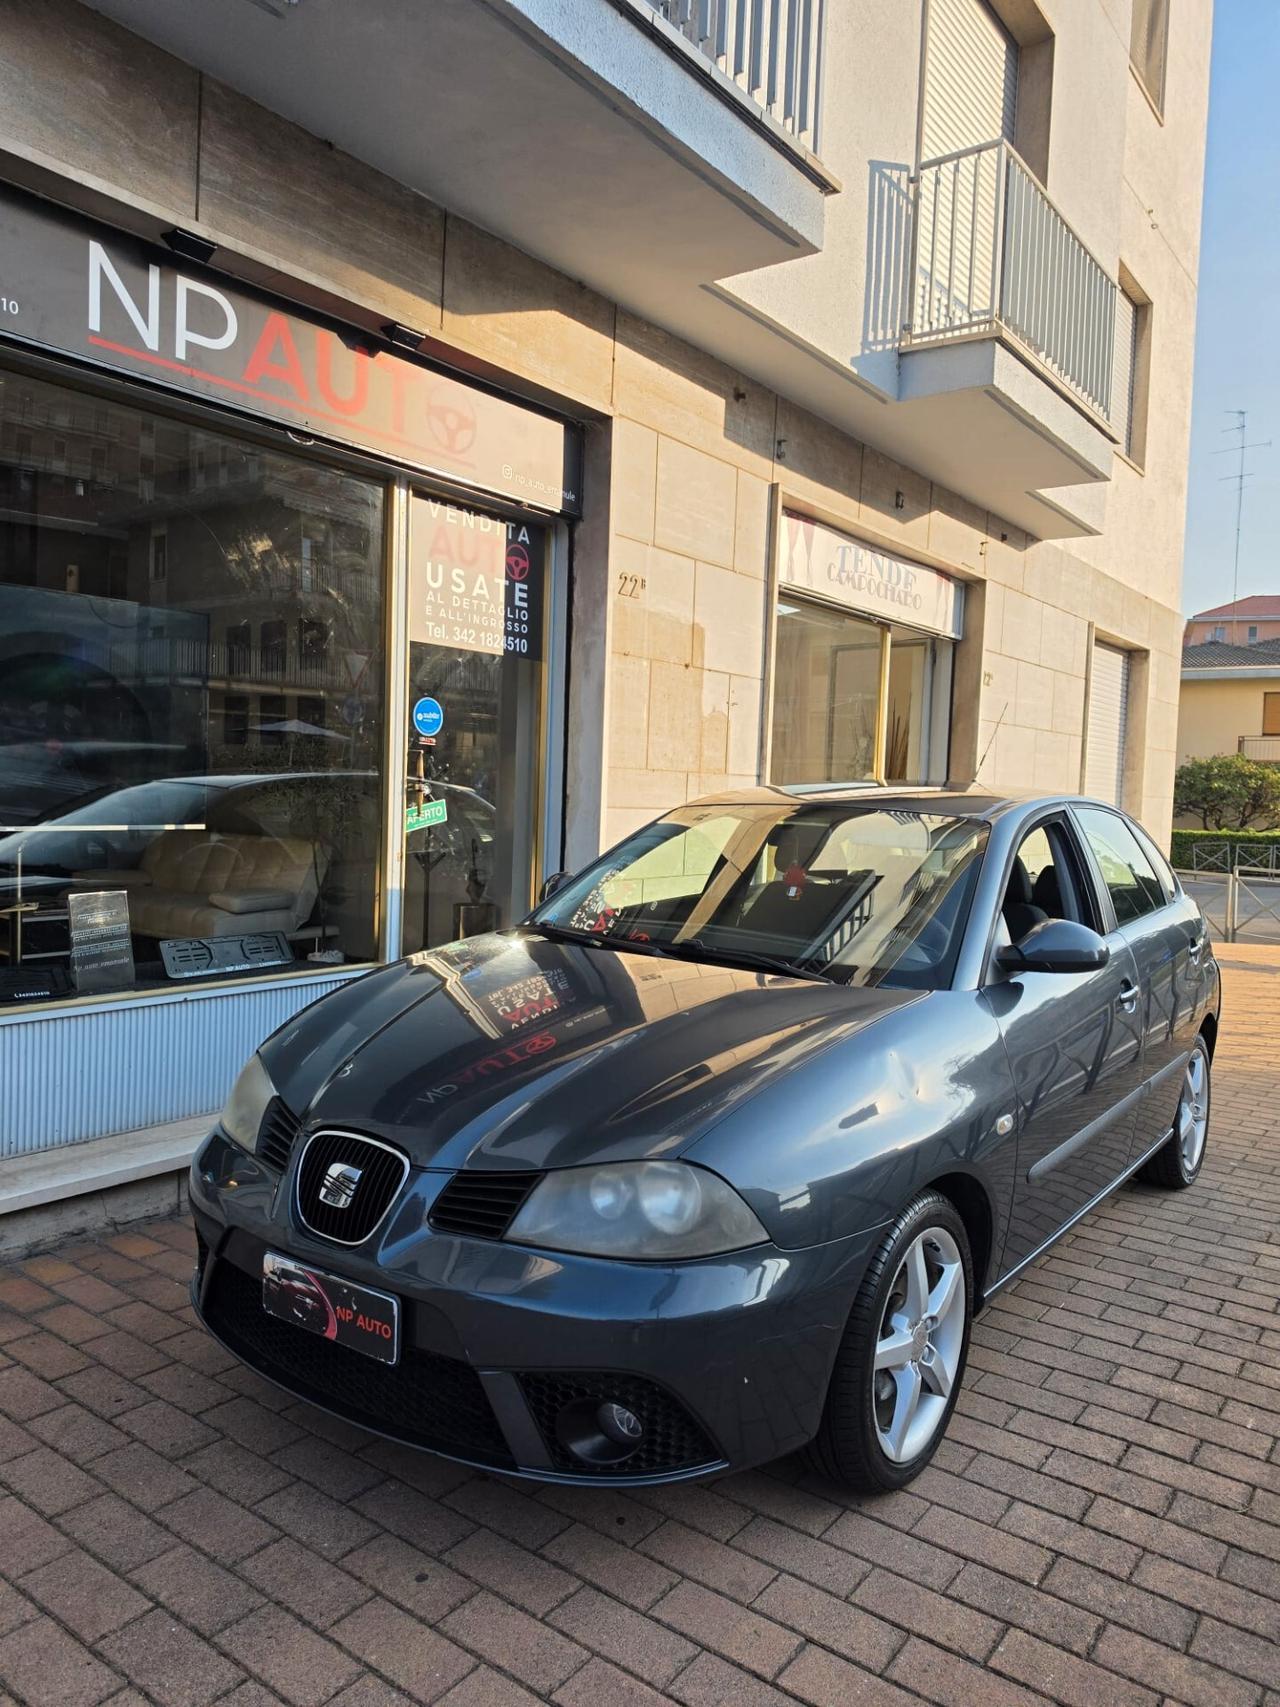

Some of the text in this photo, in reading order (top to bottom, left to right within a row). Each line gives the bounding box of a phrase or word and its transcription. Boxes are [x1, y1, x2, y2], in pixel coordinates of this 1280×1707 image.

[428, 498, 530, 545] VENDITA
[426, 561, 529, 609] USATE
[425, 605, 529, 634] E ALL'INGROSSO
[426, 590, 529, 621] AL DETTAGLIO
[426, 621, 528, 654] Tel. 342 1824510
[336, 1305, 392, 1339] NP AUTO
